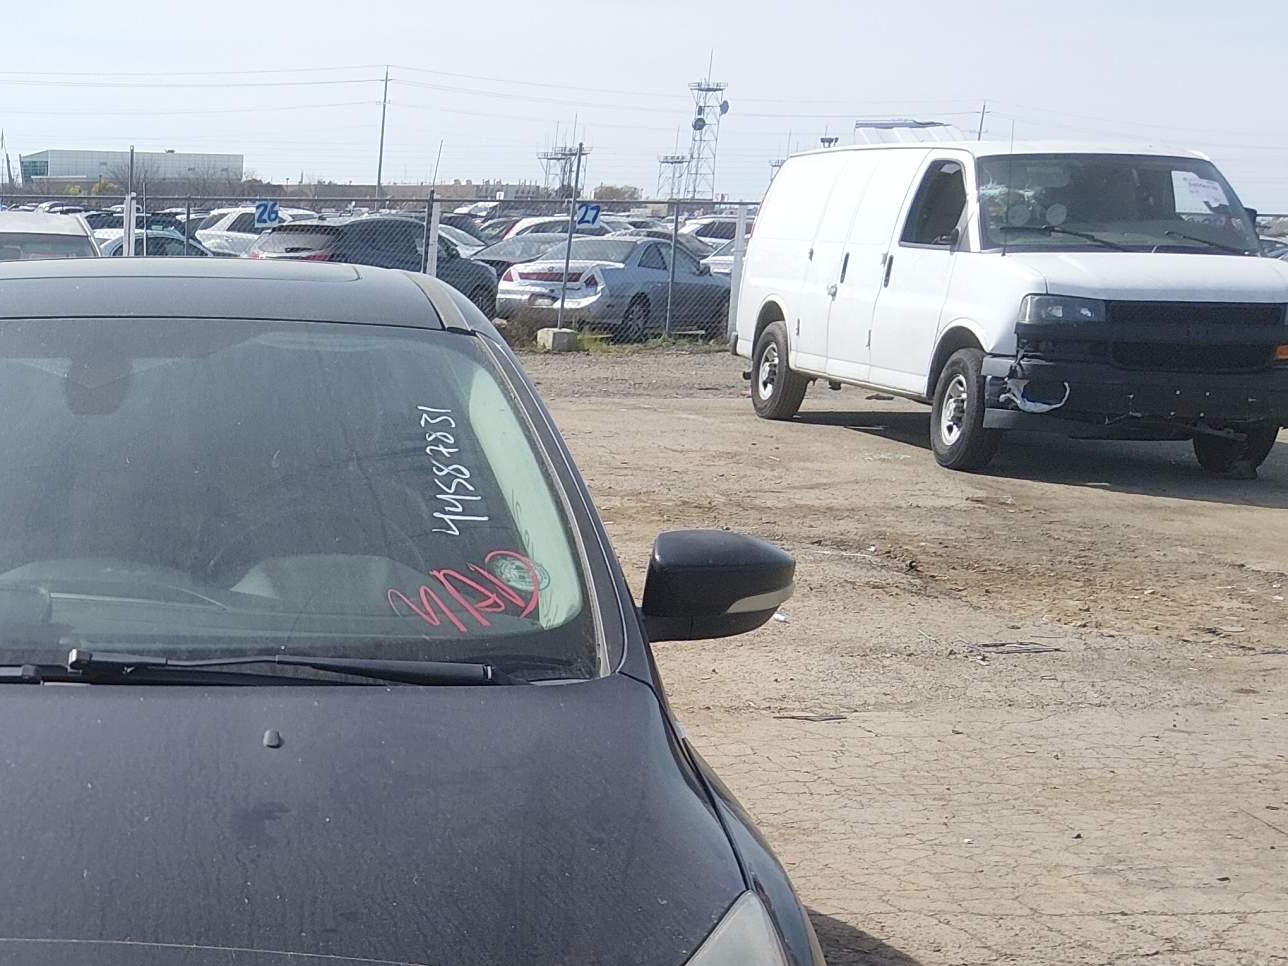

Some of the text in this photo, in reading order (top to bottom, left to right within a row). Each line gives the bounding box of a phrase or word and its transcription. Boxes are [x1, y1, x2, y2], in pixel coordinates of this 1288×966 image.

[256, 202, 279, 224] 26
[577, 203, 601, 225] 27
[417, 405, 489, 536] 44587831
